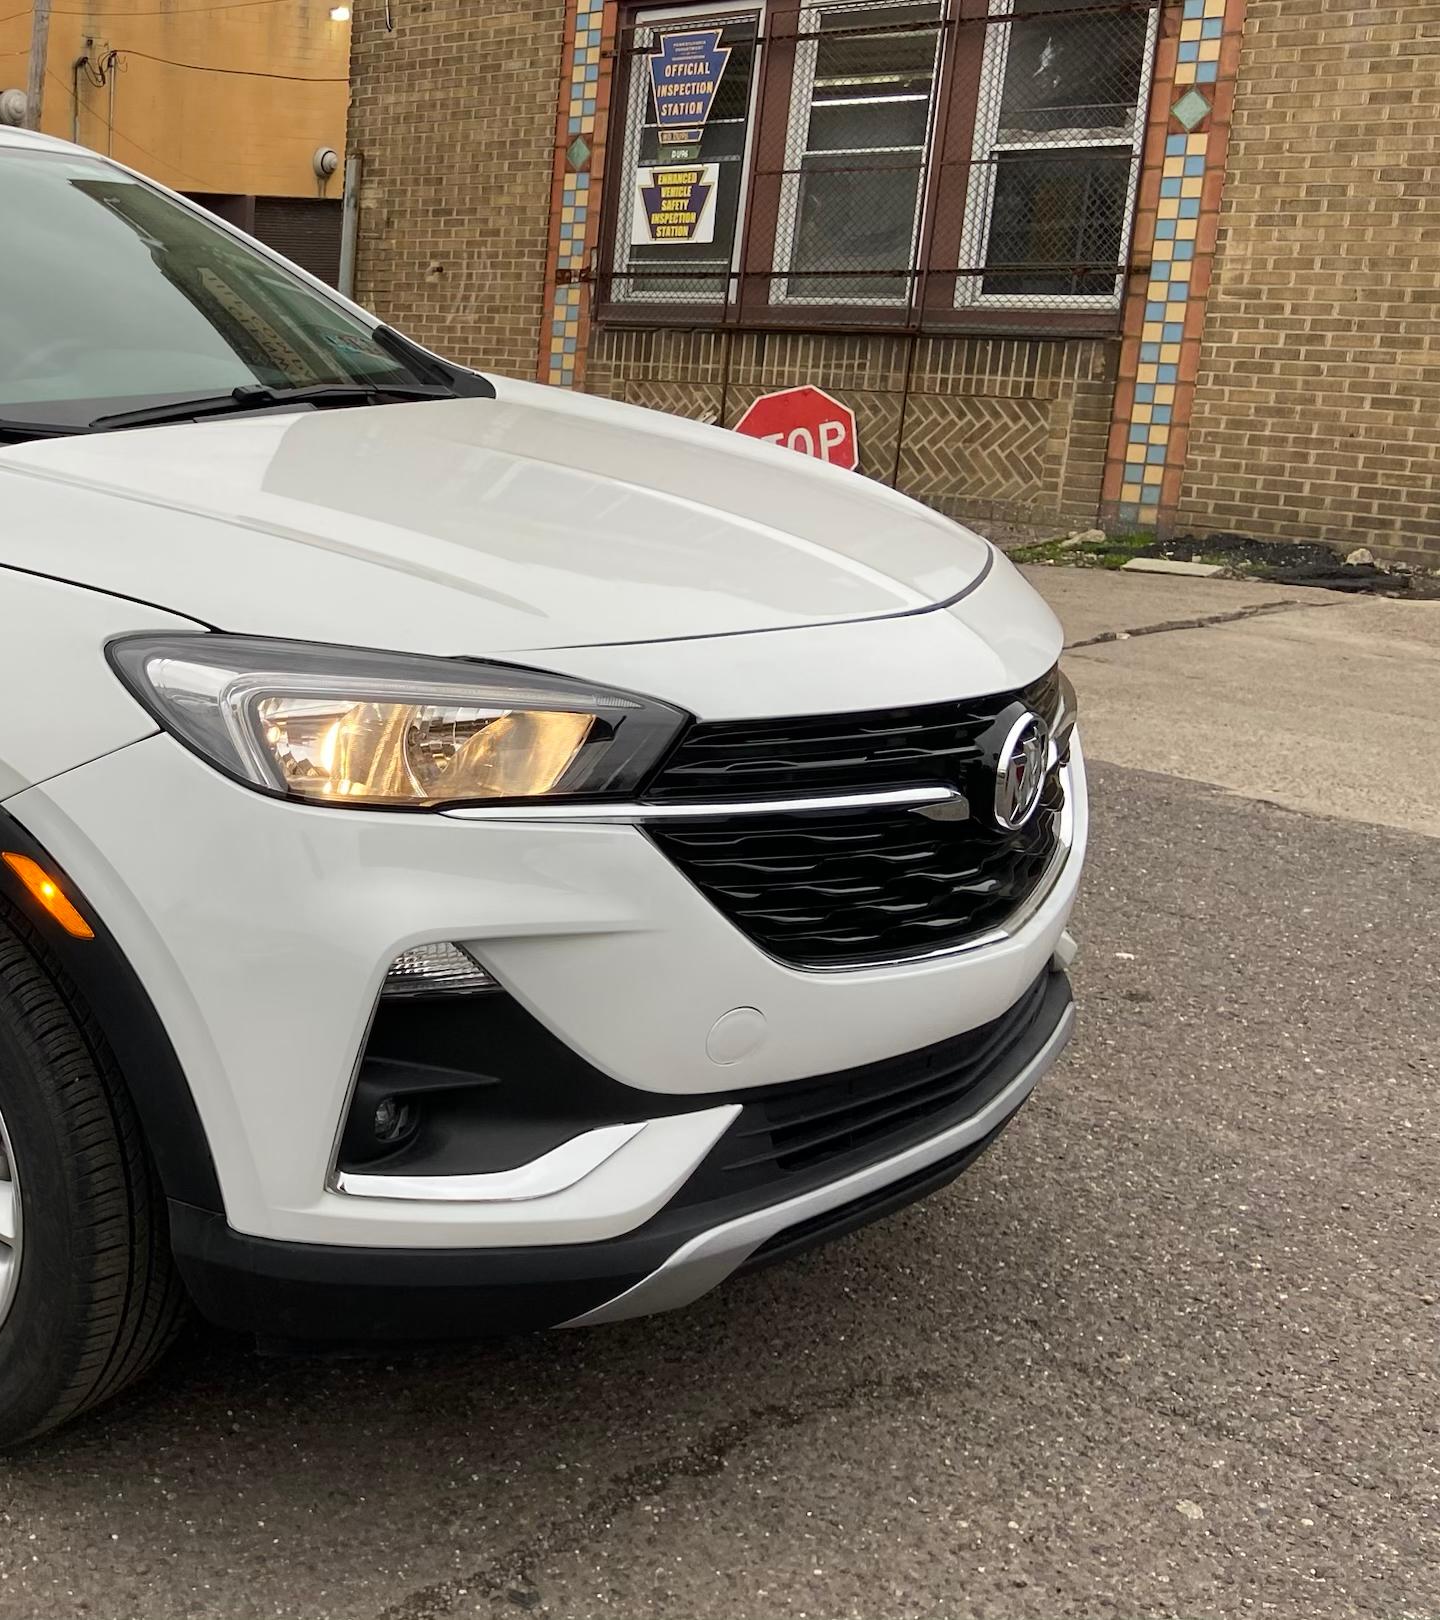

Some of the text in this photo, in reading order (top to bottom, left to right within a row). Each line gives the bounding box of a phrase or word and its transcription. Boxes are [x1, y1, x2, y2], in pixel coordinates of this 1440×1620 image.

[664, 61, 711, 78] OFFICIAL
[657, 81, 714, 98] INSPECTION
[661, 101, 704, 116] STATION
[658, 172, 698, 185] ENHANCED
[661, 185, 692, 198] VEHICLE
[661, 199, 690, 211] SAFETY
[651, 212, 697, 224] INSPECTION
[655, 225, 689, 237] STATION
[760, 420, 846, 463] OP
